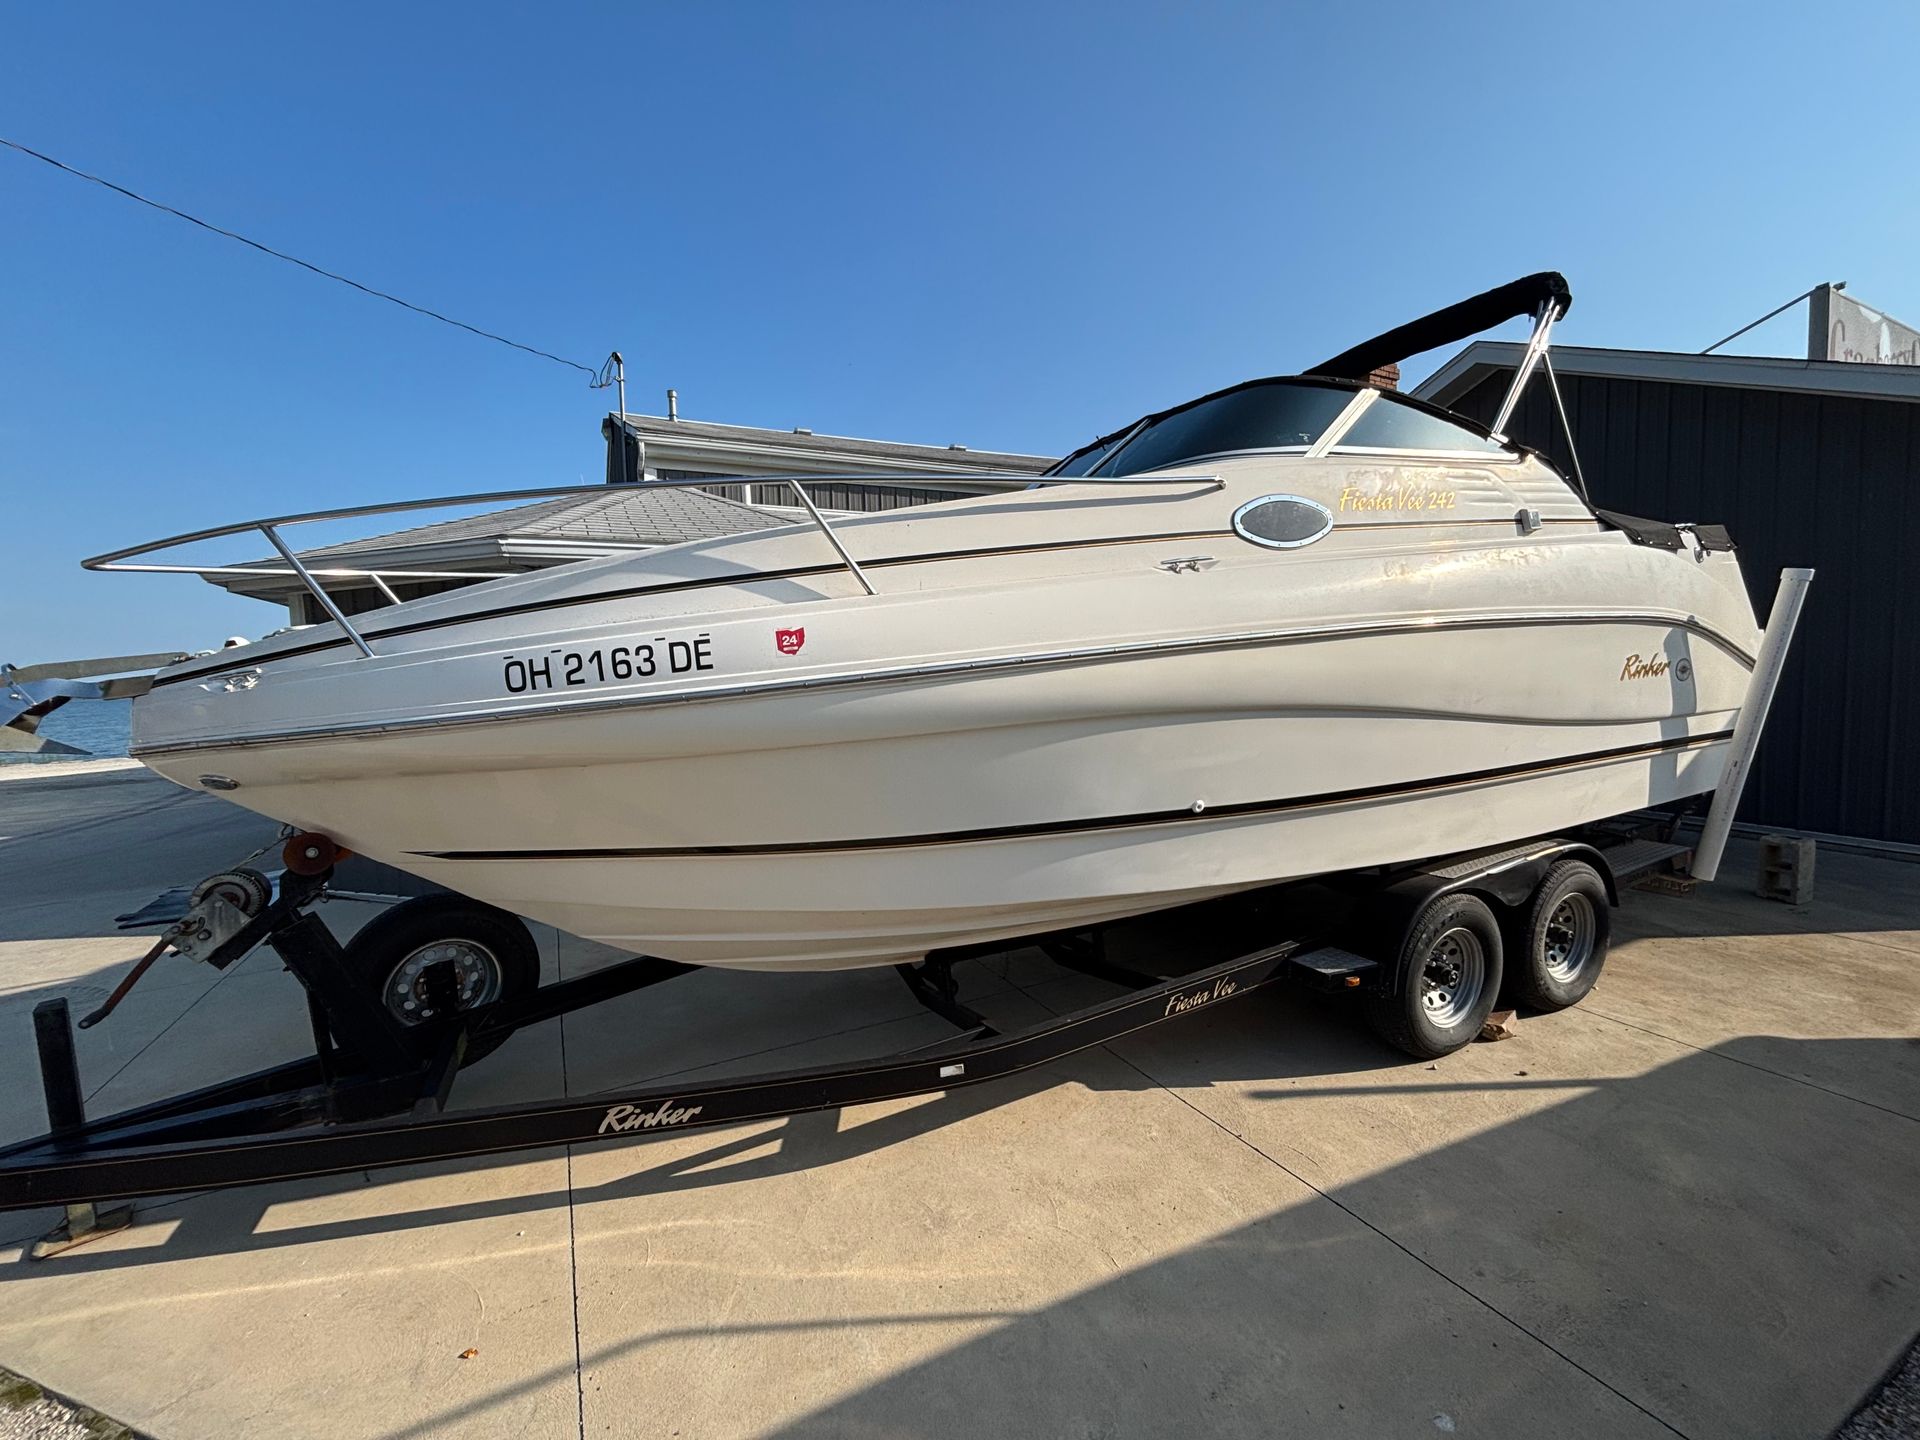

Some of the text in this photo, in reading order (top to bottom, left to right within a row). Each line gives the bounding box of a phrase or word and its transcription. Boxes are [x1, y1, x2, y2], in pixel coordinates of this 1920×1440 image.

[1339, 483, 1456, 512] Fiesta Vee 242
[781, 635, 798, 646] 24
[504, 637, 714, 693] OH 2163 DE
[1620, 652, 1671, 681] Rinker
[1164, 976, 1237, 1016] Fiesta Vee
[598, 1100, 703, 1133] Rinker
